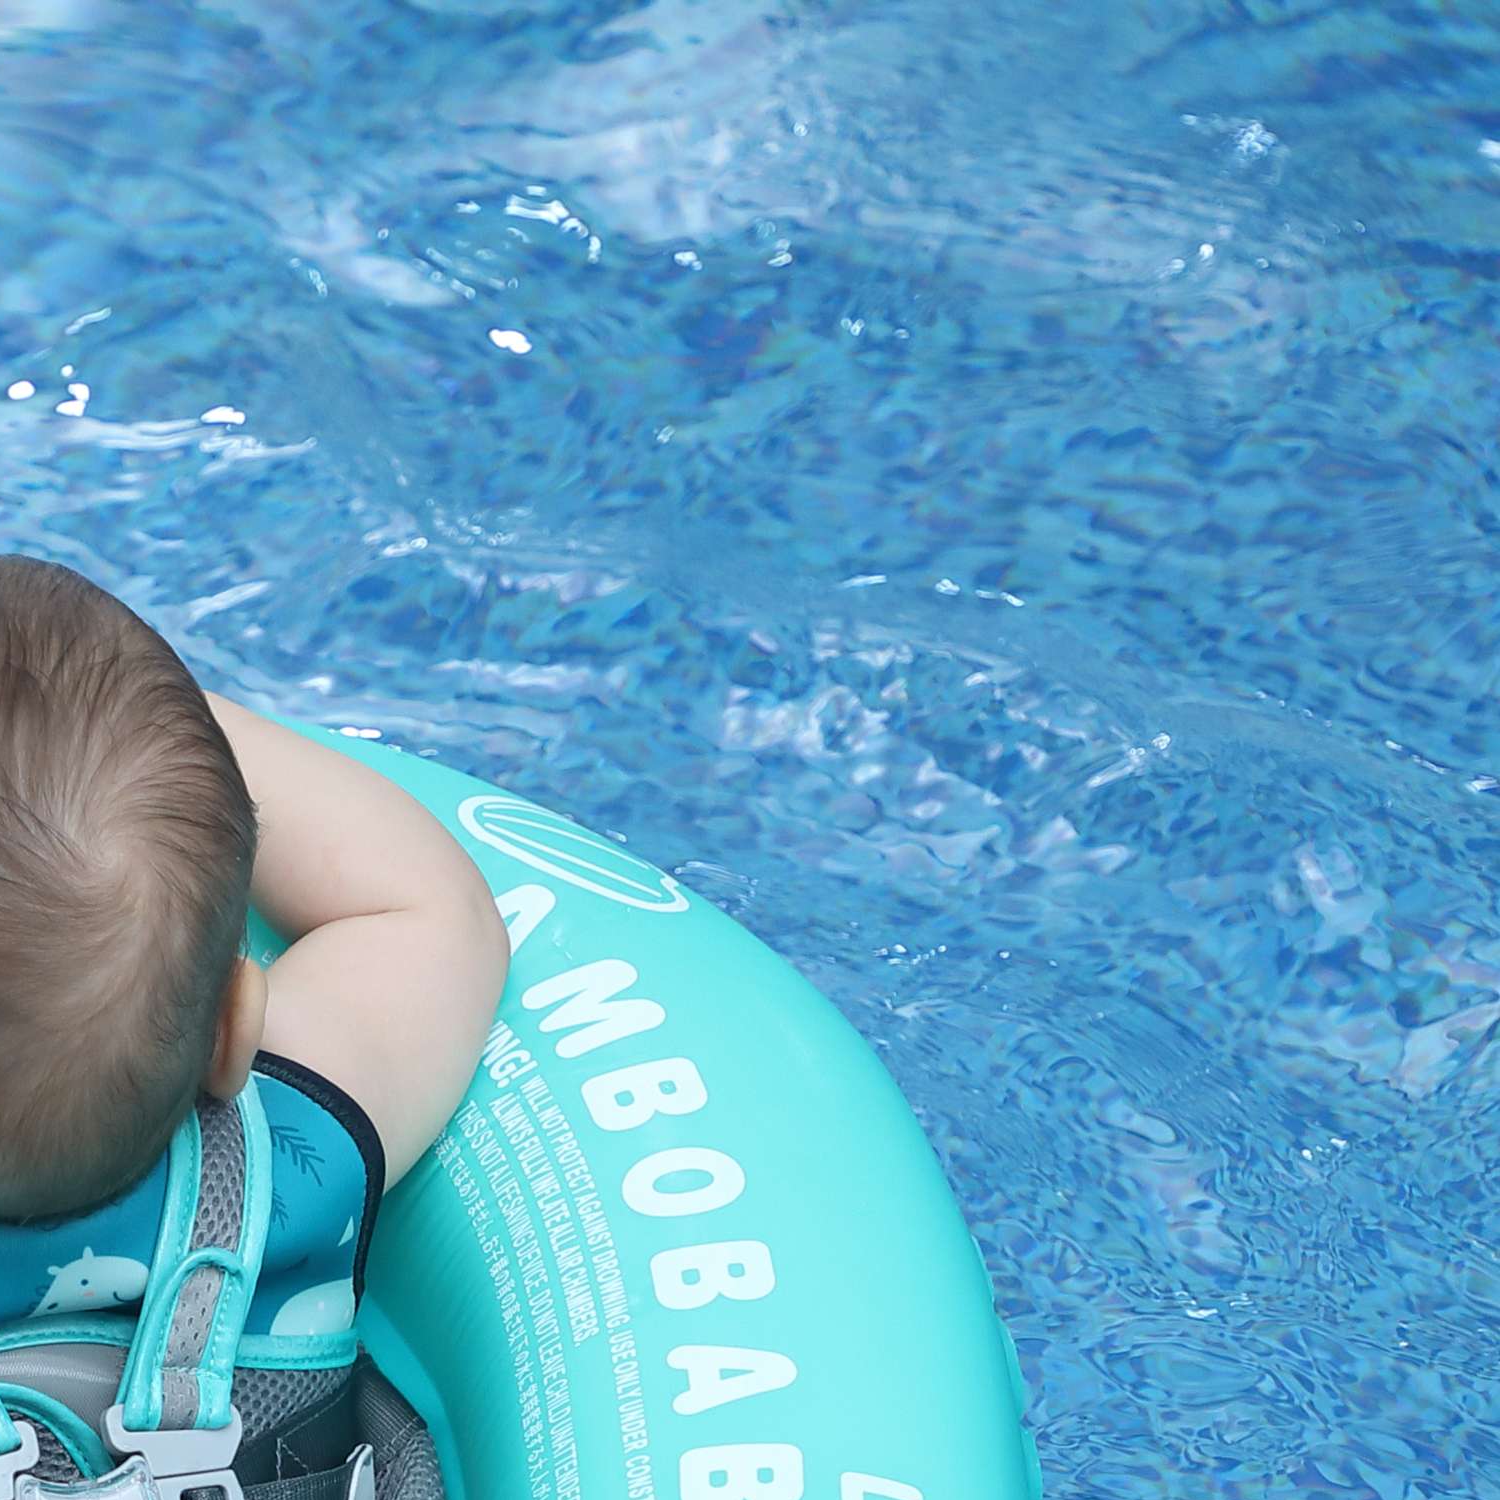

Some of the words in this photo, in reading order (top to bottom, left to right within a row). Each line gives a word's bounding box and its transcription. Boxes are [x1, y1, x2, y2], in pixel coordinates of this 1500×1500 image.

[518, 1073, 554, 1113] WILL
[486, 1091, 535, 1145] ALWAYS
[535, 1102, 571, 1137] NOT
[475, 1138, 506, 1170] NOT
[511, 1134, 553, 1176] FULLY
[548, 1129, 596, 1194] PROTECT
[527, 1169, 573, 1226] INFLATE
[545, 1222, 578, 1251] ALL
[572, 1190, 614, 1251] AGAINST
[514, 1239, 548, 1297] DEVICE.
[552, 1245, 585, 1274] AIR
[527, 1288, 553, 1316] DO
[558, 1264, 602, 1347] CHAMBERS.
[591, 1248, 630, 1332] DROWNING.
[531, 1308, 560, 1336] NOT
[537, 1336, 568, 1385] LEAVE
[609, 1330, 636, 1363] USE
[543, 1378, 572, 1423] CHILD
[613, 1360, 642, 1399] ONLY
[619, 1401, 647, 1452] UNDER
